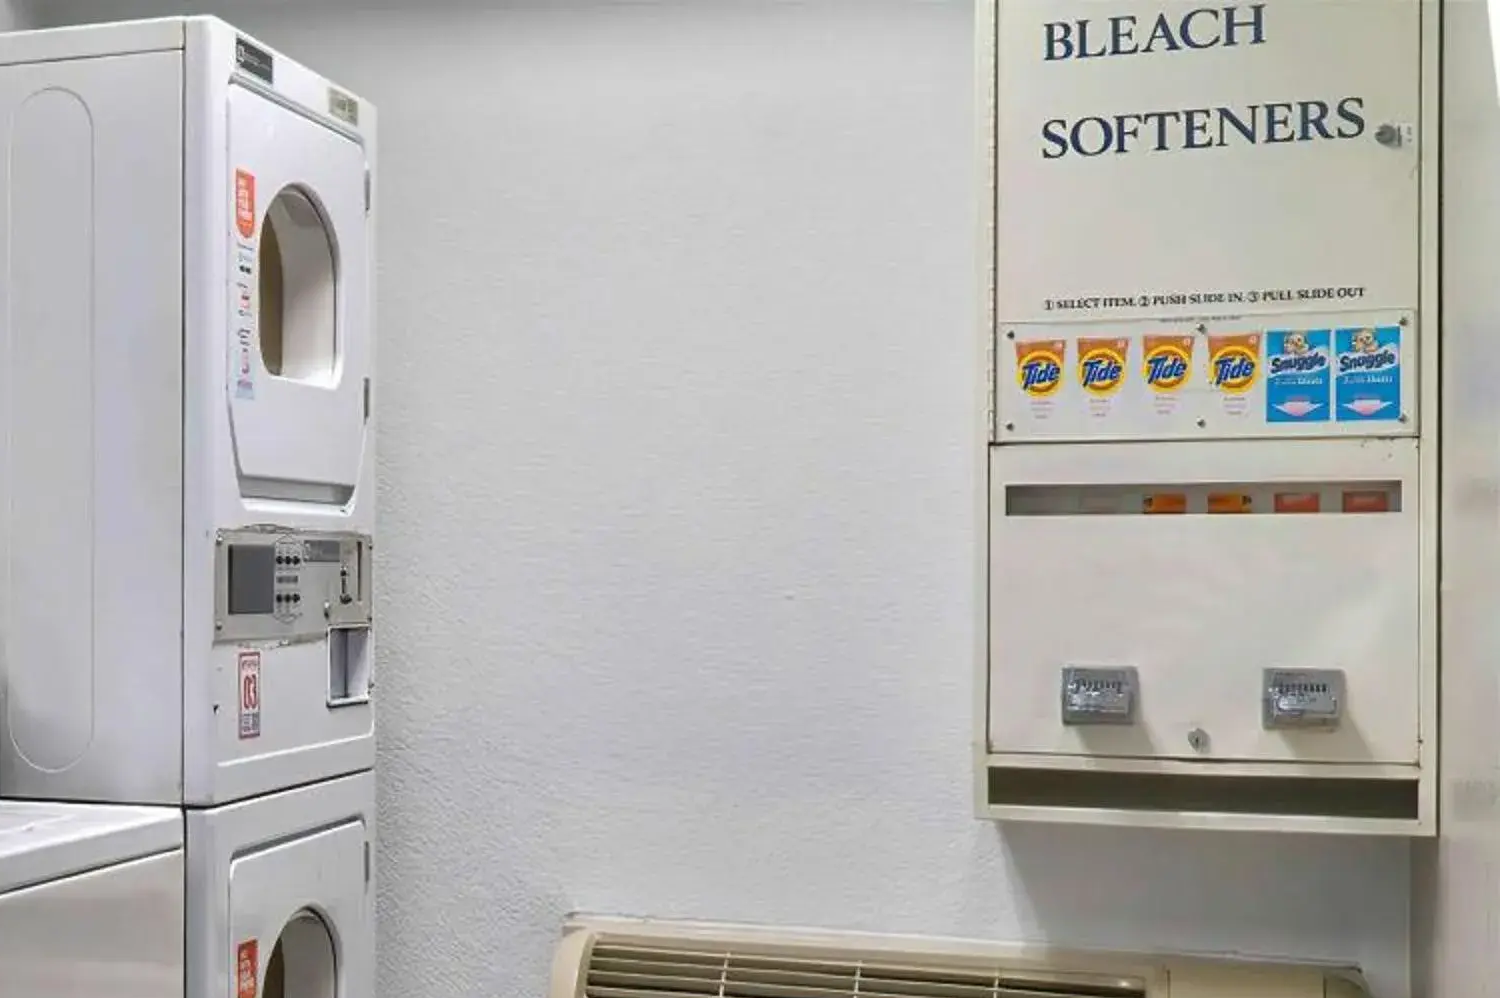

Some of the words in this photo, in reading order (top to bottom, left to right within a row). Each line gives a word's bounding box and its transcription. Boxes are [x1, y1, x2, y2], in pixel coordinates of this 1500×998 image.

[1043, 4, 1267, 61] BLEACH
[1041, 97, 1366, 160] SOFTENERS
[1056, 297, 1100, 309] SELECT
[1153, 294, 1187, 305] PUSH
[1188, 293, 1225, 304] SLIDE
[1261, 289, 1293, 301] PULL
[1297, 288, 1334, 299] SLIDE
[1337, 287, 1366, 298] OUT
[1022, 361, 1061, 391] Tide
[1082, 359, 1122, 387] Tide
[1147, 355, 1187, 384] Tide
[1214, 355, 1255, 385] Tide
[1271, 351, 1326, 374] Snuggle
[1339, 351, 1395, 373] Snuggle
